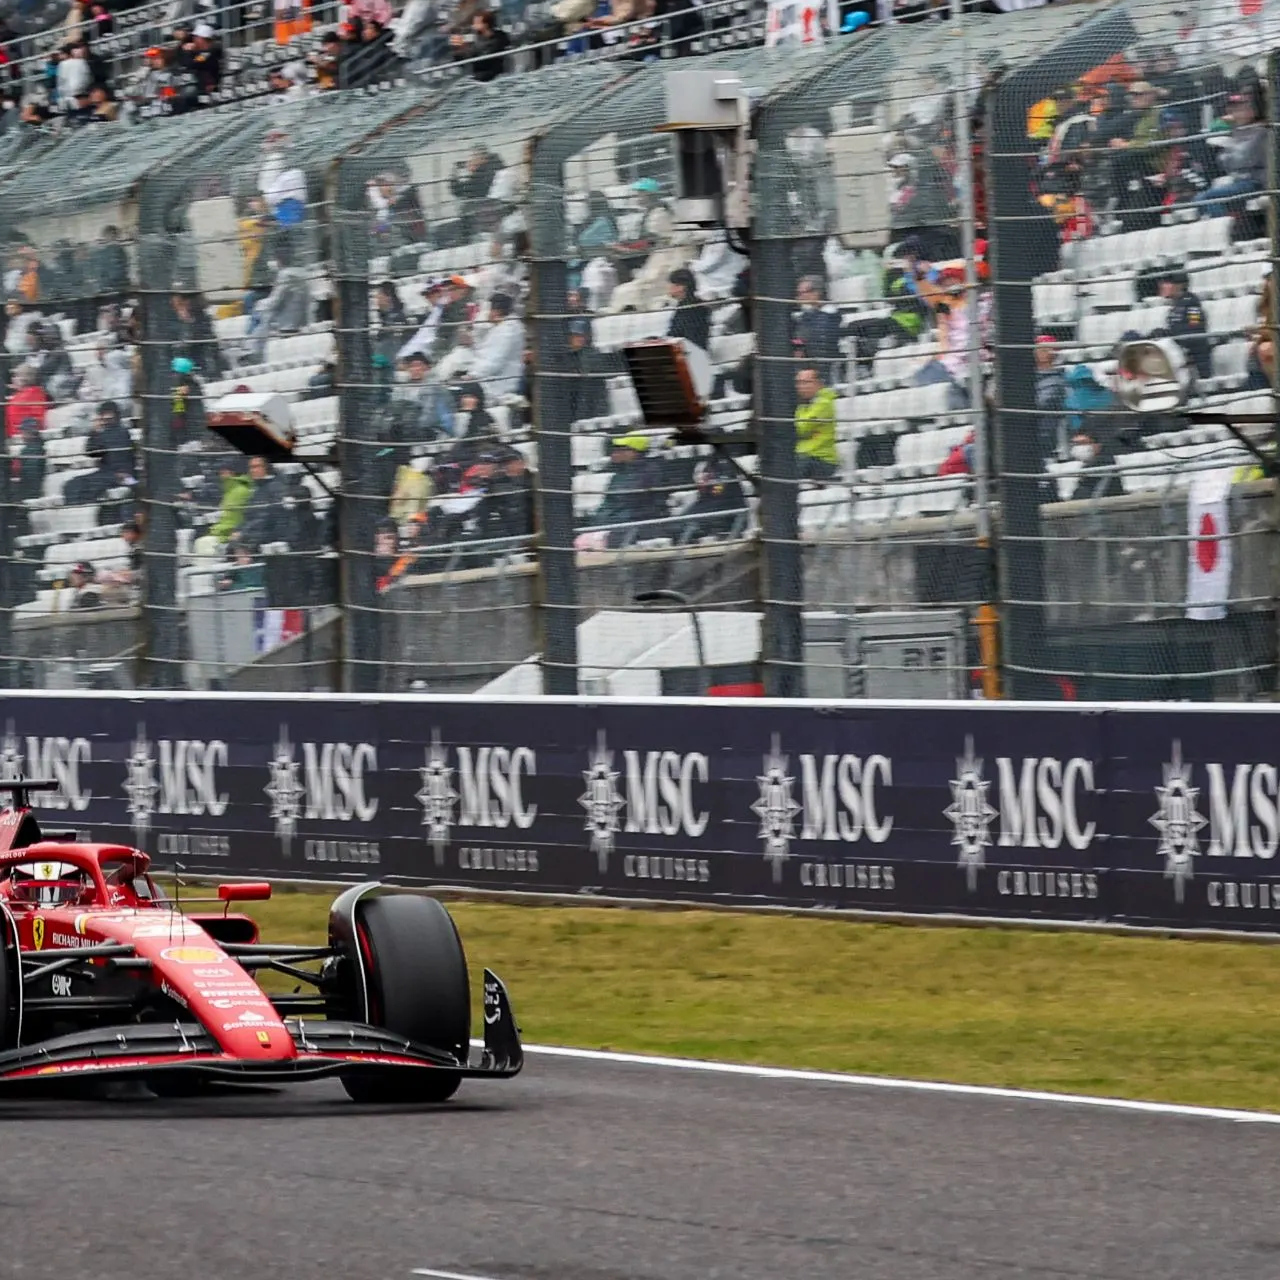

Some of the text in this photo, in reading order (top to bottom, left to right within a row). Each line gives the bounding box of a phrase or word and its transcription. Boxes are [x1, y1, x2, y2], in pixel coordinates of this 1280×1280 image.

[26, 736, 93, 811] MSC
[158, 739, 230, 816] MSC
[302, 742, 379, 821] MSC
[456, 746, 538, 828] MSC
[622, 750, 710, 837] MSC
[799, 754, 894, 842] MSC
[995, 757, 1096, 849] MSC
[624, 855, 710, 882] CRUISES
[800, 862, 895, 890] CRUISES
[997, 870, 1098, 899] CRUISES
[52, 932, 80, 950] RICHARD
